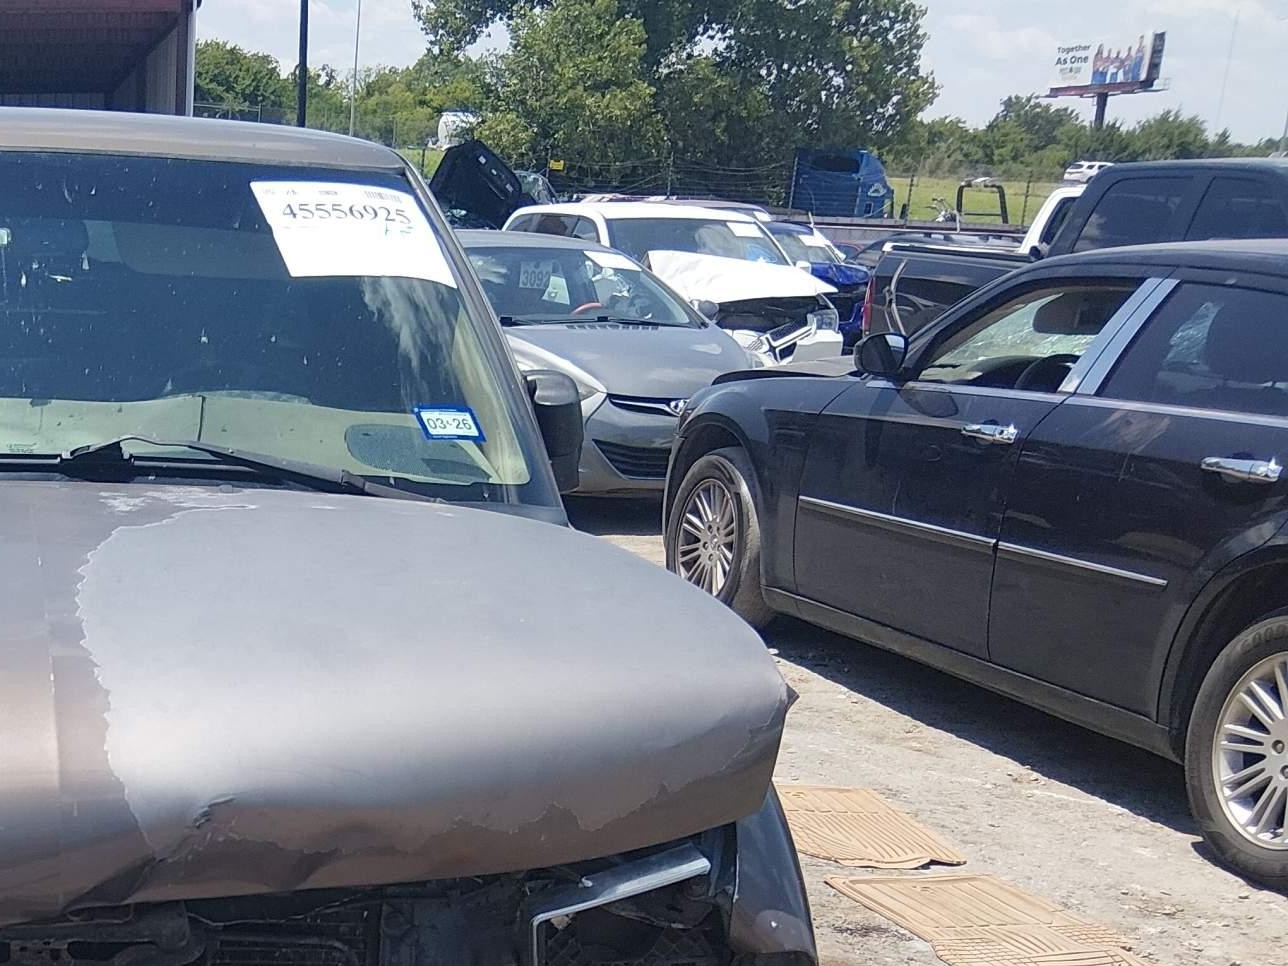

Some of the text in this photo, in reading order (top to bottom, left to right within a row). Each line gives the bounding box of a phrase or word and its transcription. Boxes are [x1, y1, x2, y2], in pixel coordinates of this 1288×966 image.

[1057, 44, 1091, 55] Together
[1055, 55, 1089, 65] As One
[282, 203, 412, 225] 45556925
